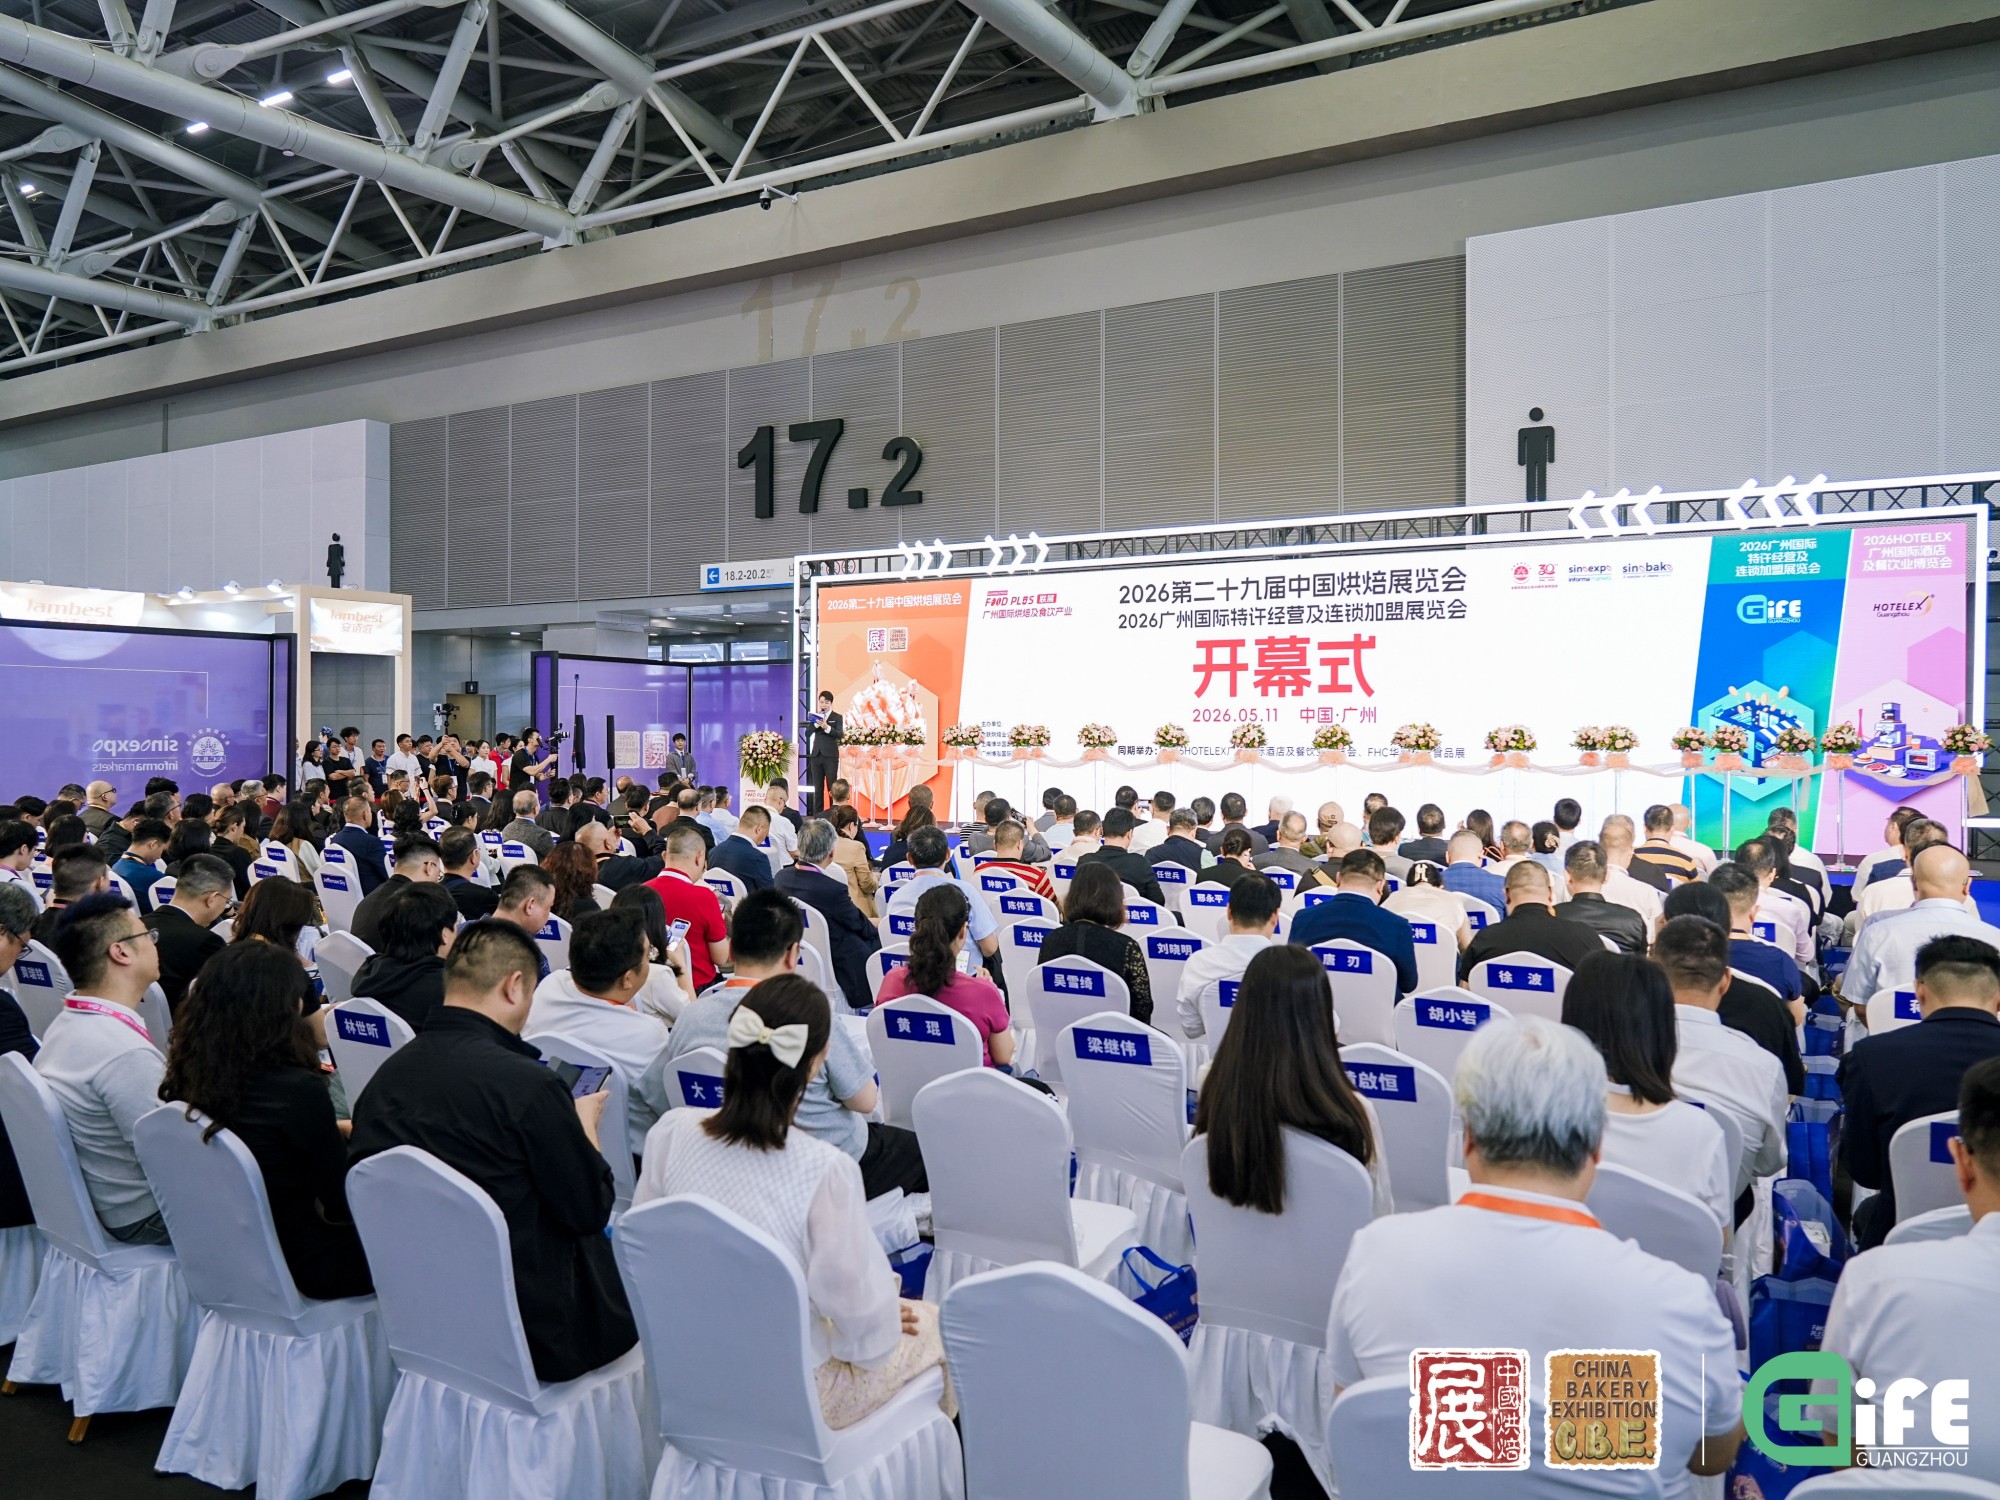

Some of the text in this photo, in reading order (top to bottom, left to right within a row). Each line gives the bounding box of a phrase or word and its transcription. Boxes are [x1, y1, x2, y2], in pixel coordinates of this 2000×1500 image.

[737, 418, 923, 519] 17.2
[1739, 538, 1817, 552] 2026广州国际
[1863, 532, 1952, 546] 2026HOTELEX
[1747, 551, 1808, 564] 特许经营及
[1868, 545, 1946, 558] 广州国际酒店
[1735, 562, 1821, 577] 连锁加盟展览会
[1862, 557, 1952, 572] 及餐饮业博览会
[724, 569, 766, 581] 18.2-20.2
[1119, 566, 1467, 604] 2026第二十九届中国烘焙展览会
[827, 593, 962, 611] 2026第二十九届中国烘焙展览会
[1873, 595, 1929, 612] HOTELEX
[1118, 599, 1467, 629] 2026广州国际特许经营及连锁加盟展览会
[1193, 633, 1376, 698] 开幕式
[1193, 708, 1278, 722] 2026.05.11
[1157, 943, 1193, 956] 刘晓明
[1054, 973, 1093, 990] 吴雪绮
[1428, 1006, 1477, 1025] 胡小岩
[1086, 1036, 1137, 1057] 梁继伟
